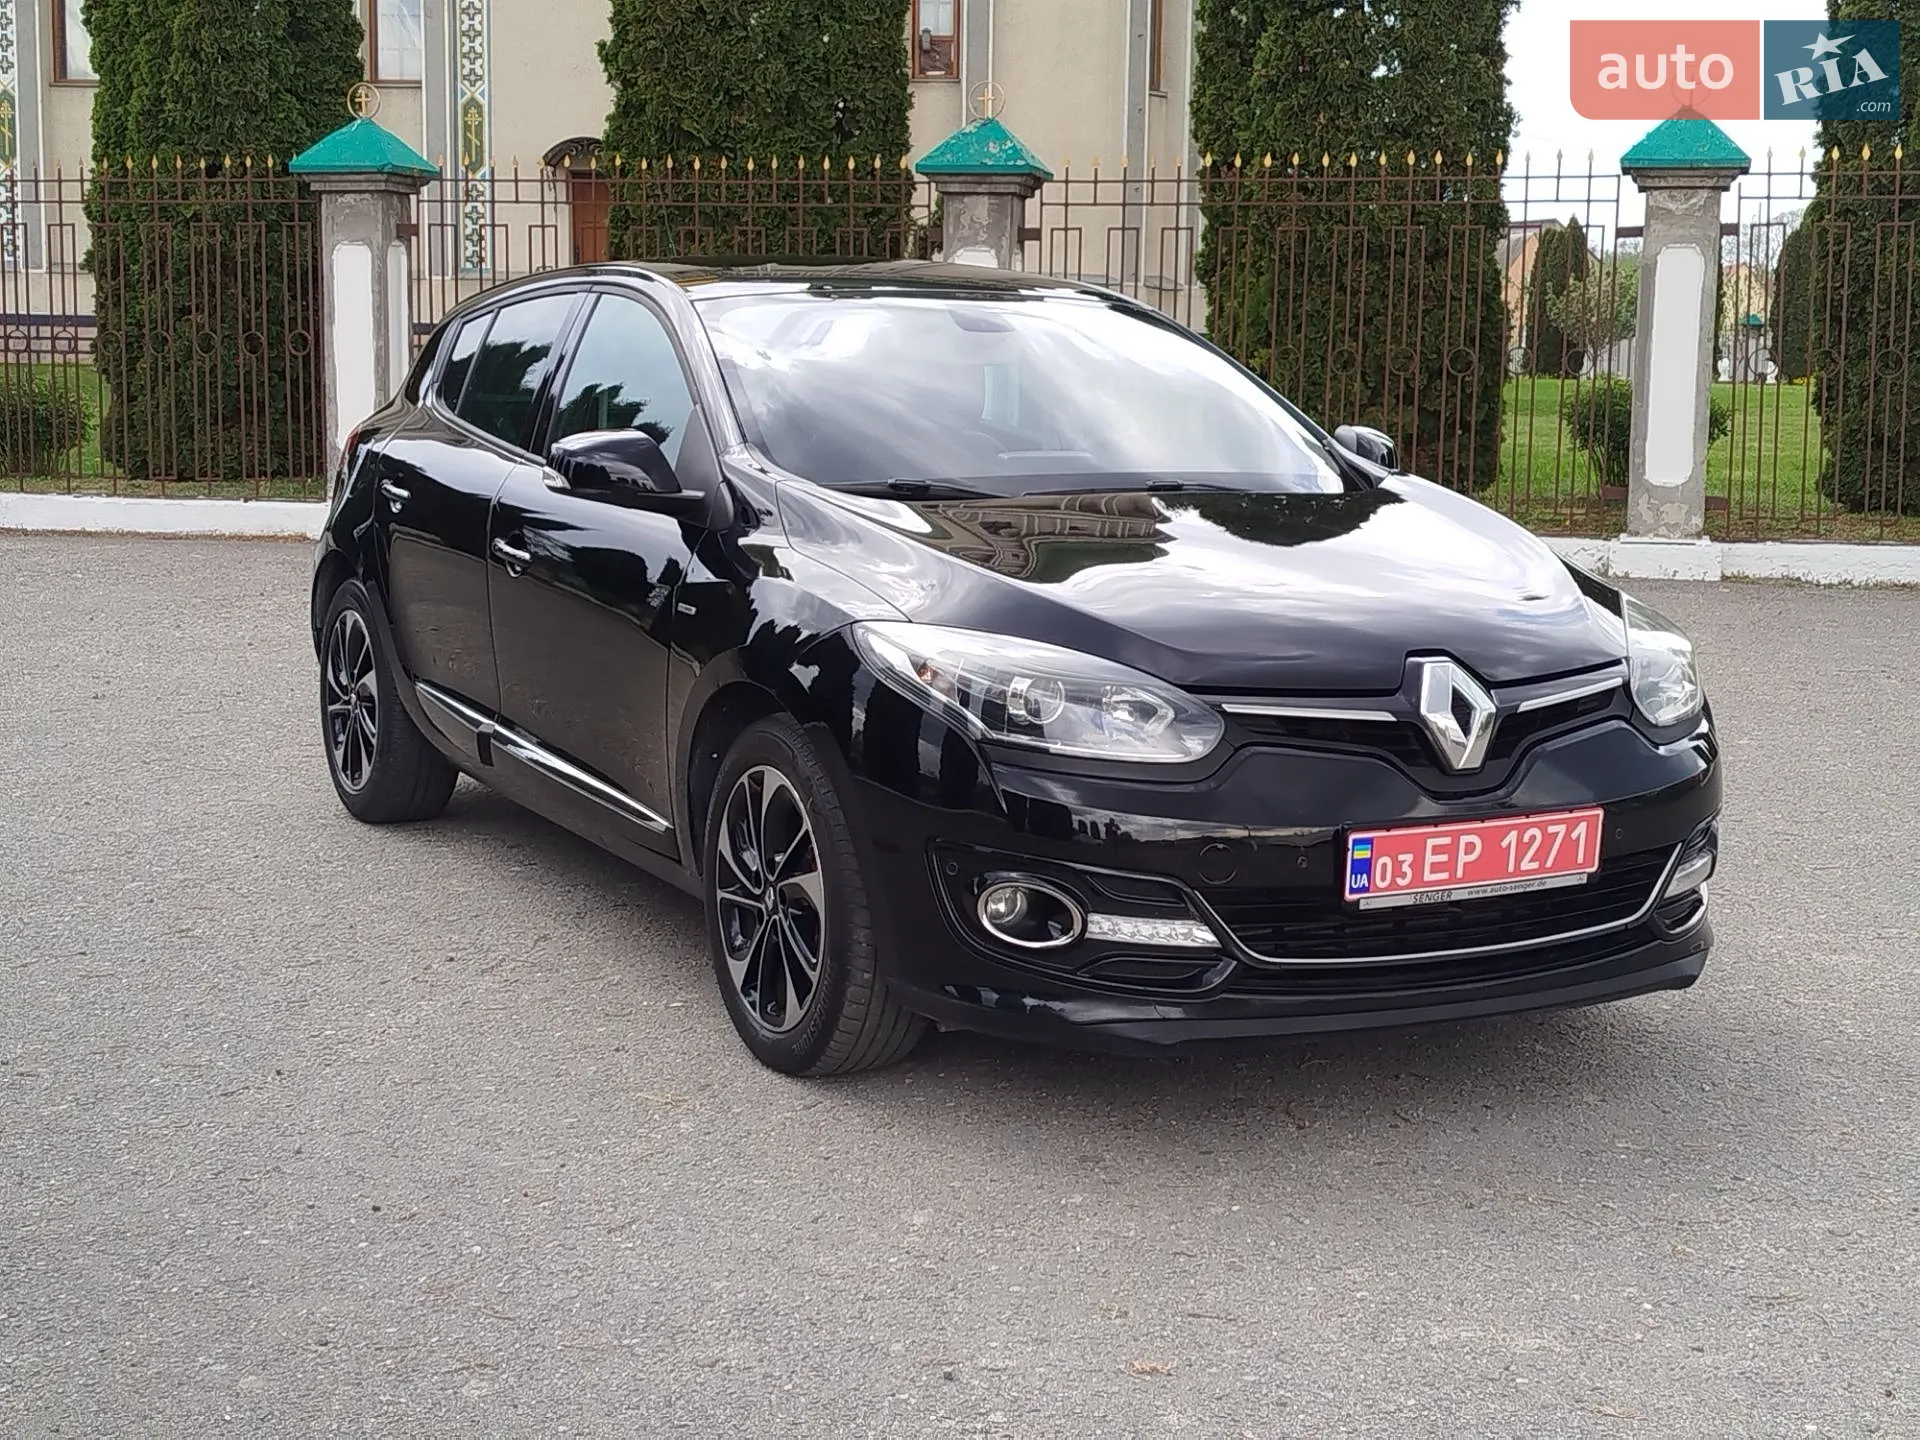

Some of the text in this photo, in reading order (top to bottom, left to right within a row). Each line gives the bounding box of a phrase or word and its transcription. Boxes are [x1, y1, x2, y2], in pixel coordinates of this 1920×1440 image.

[1375, 821, 1588, 888] 03 EP 1271
[1351, 873, 1368, 889] UA
[1412, 880, 1548, 904] SENGER www.auto-senger.de
